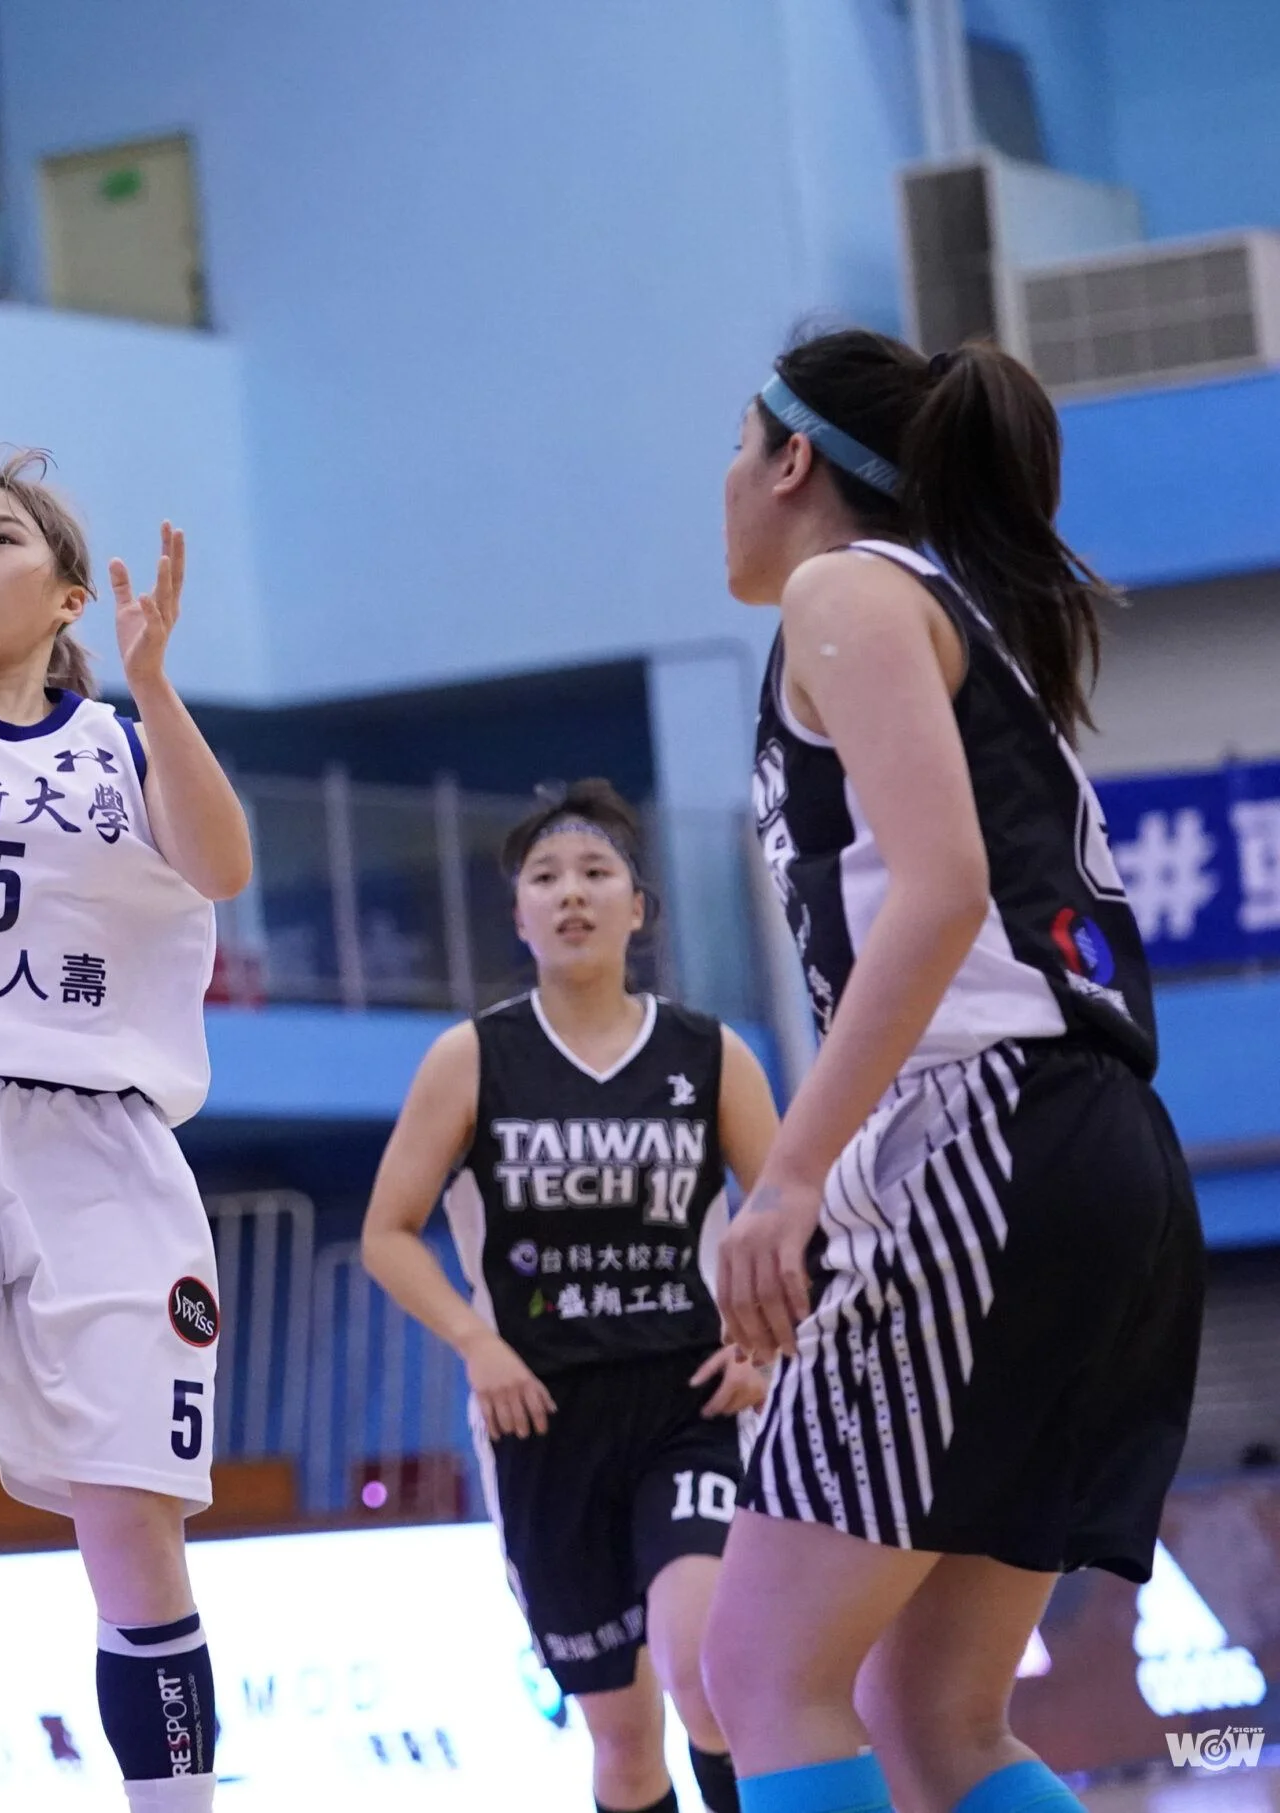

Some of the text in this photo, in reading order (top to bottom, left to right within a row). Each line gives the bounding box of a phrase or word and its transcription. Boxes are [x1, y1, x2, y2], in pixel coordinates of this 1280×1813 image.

[490, 1118, 706, 1164] TAIWAN
[494, 1164, 638, 1211] TECH
[643, 1165, 699, 1229] 10
[170, 1378, 204, 1461] 5
[671, 1469, 737, 1524] 10
